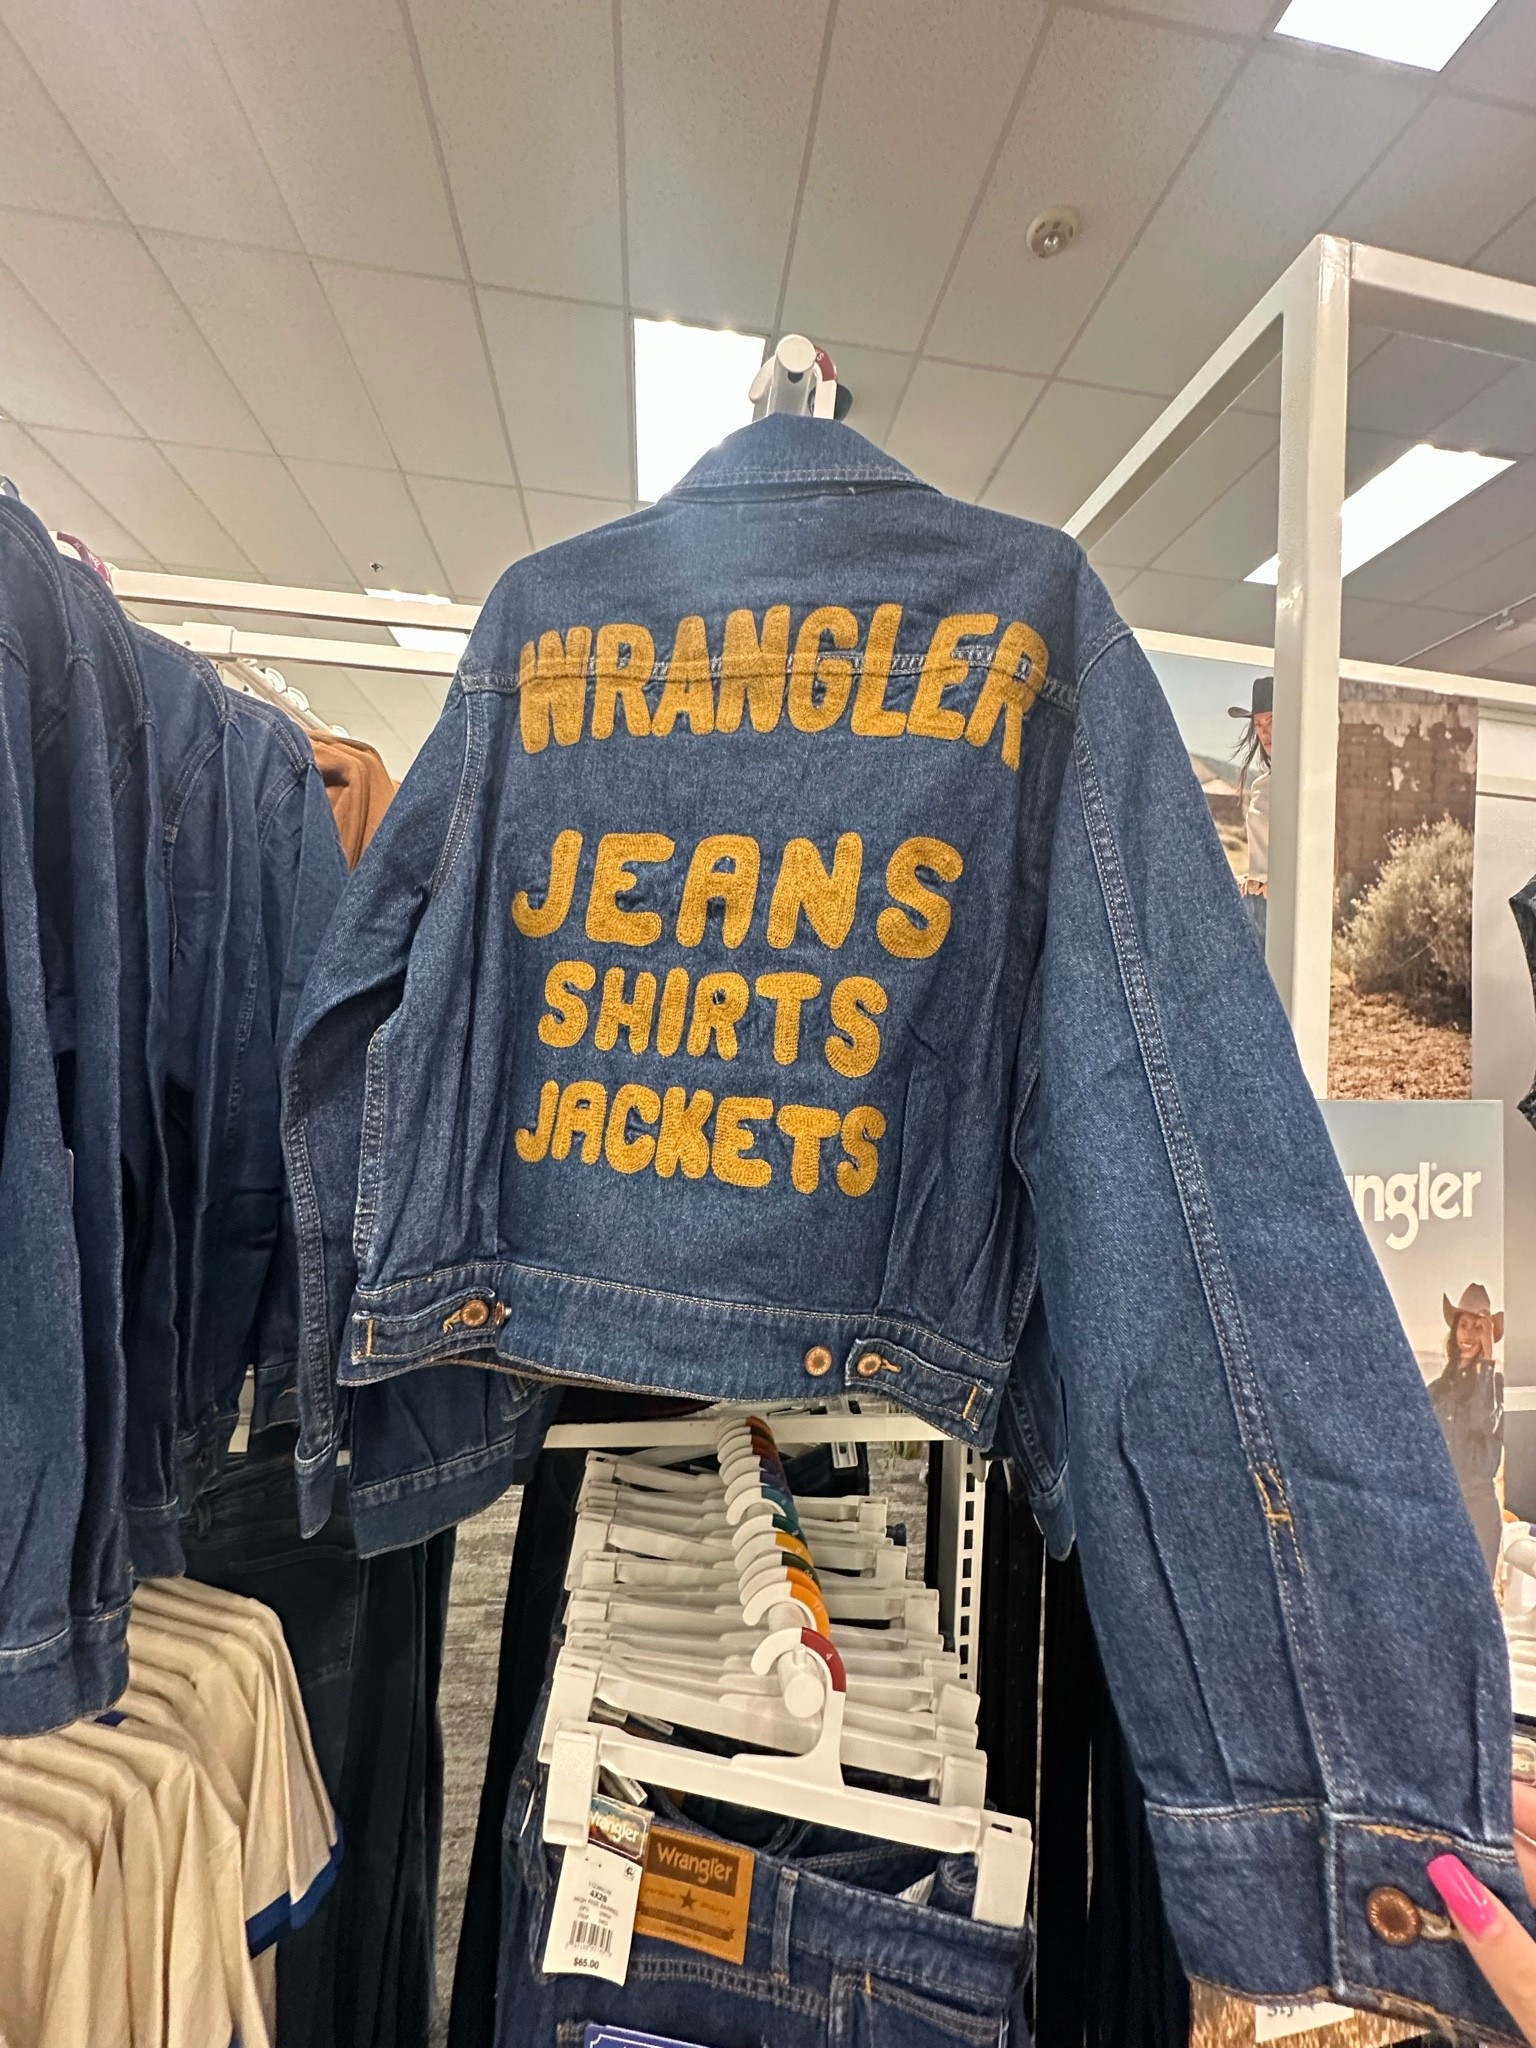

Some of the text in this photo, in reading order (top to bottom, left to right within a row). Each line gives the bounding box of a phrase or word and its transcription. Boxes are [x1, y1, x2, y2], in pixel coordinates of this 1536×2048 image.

[519, 603, 1049, 771] WRANGLER
[511, 829, 963, 959] JEANS
[538, 961, 888, 1078] SHIRTS
[514, 1079, 887, 1197] JACKETS
[1344, 1161, 1482, 1250] ngler
[657, 1841, 734, 1884] Wrangler
[573, 1957, 600, 1970] $65.00
